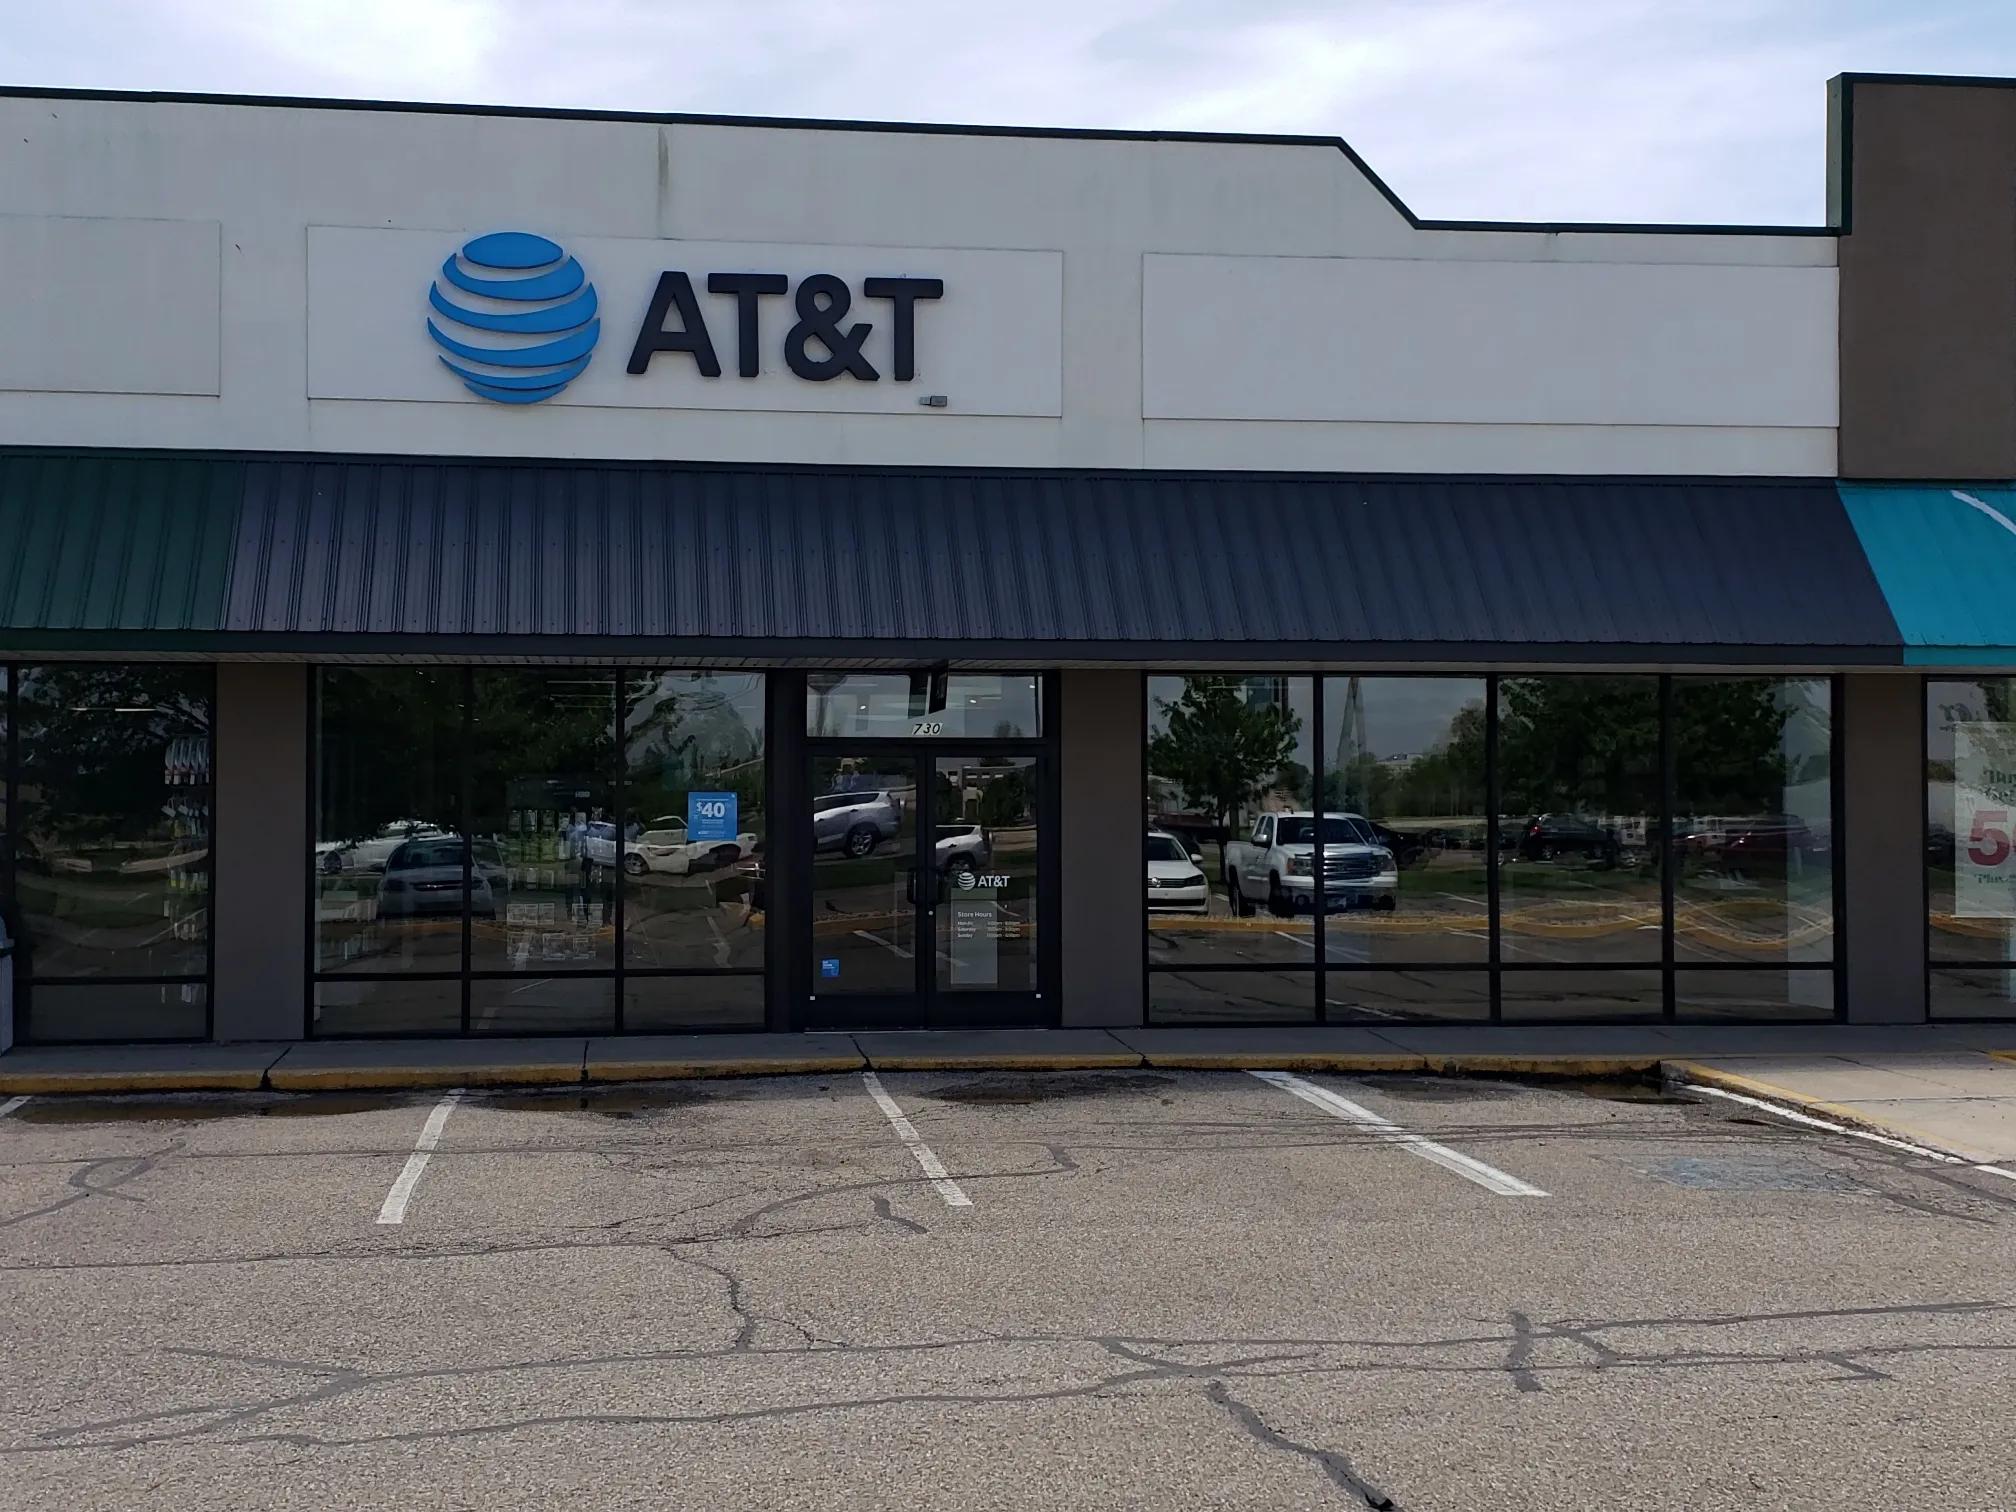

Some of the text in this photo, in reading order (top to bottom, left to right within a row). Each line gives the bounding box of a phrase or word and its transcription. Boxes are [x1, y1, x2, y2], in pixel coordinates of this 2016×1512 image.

[626, 270, 944, 382] AT&T
[913, 723, 941, 735] 730
[696, 801, 726, 818] $40
[1967, 810, 2016, 866] 5
[977, 875, 1011, 888] AT&T
